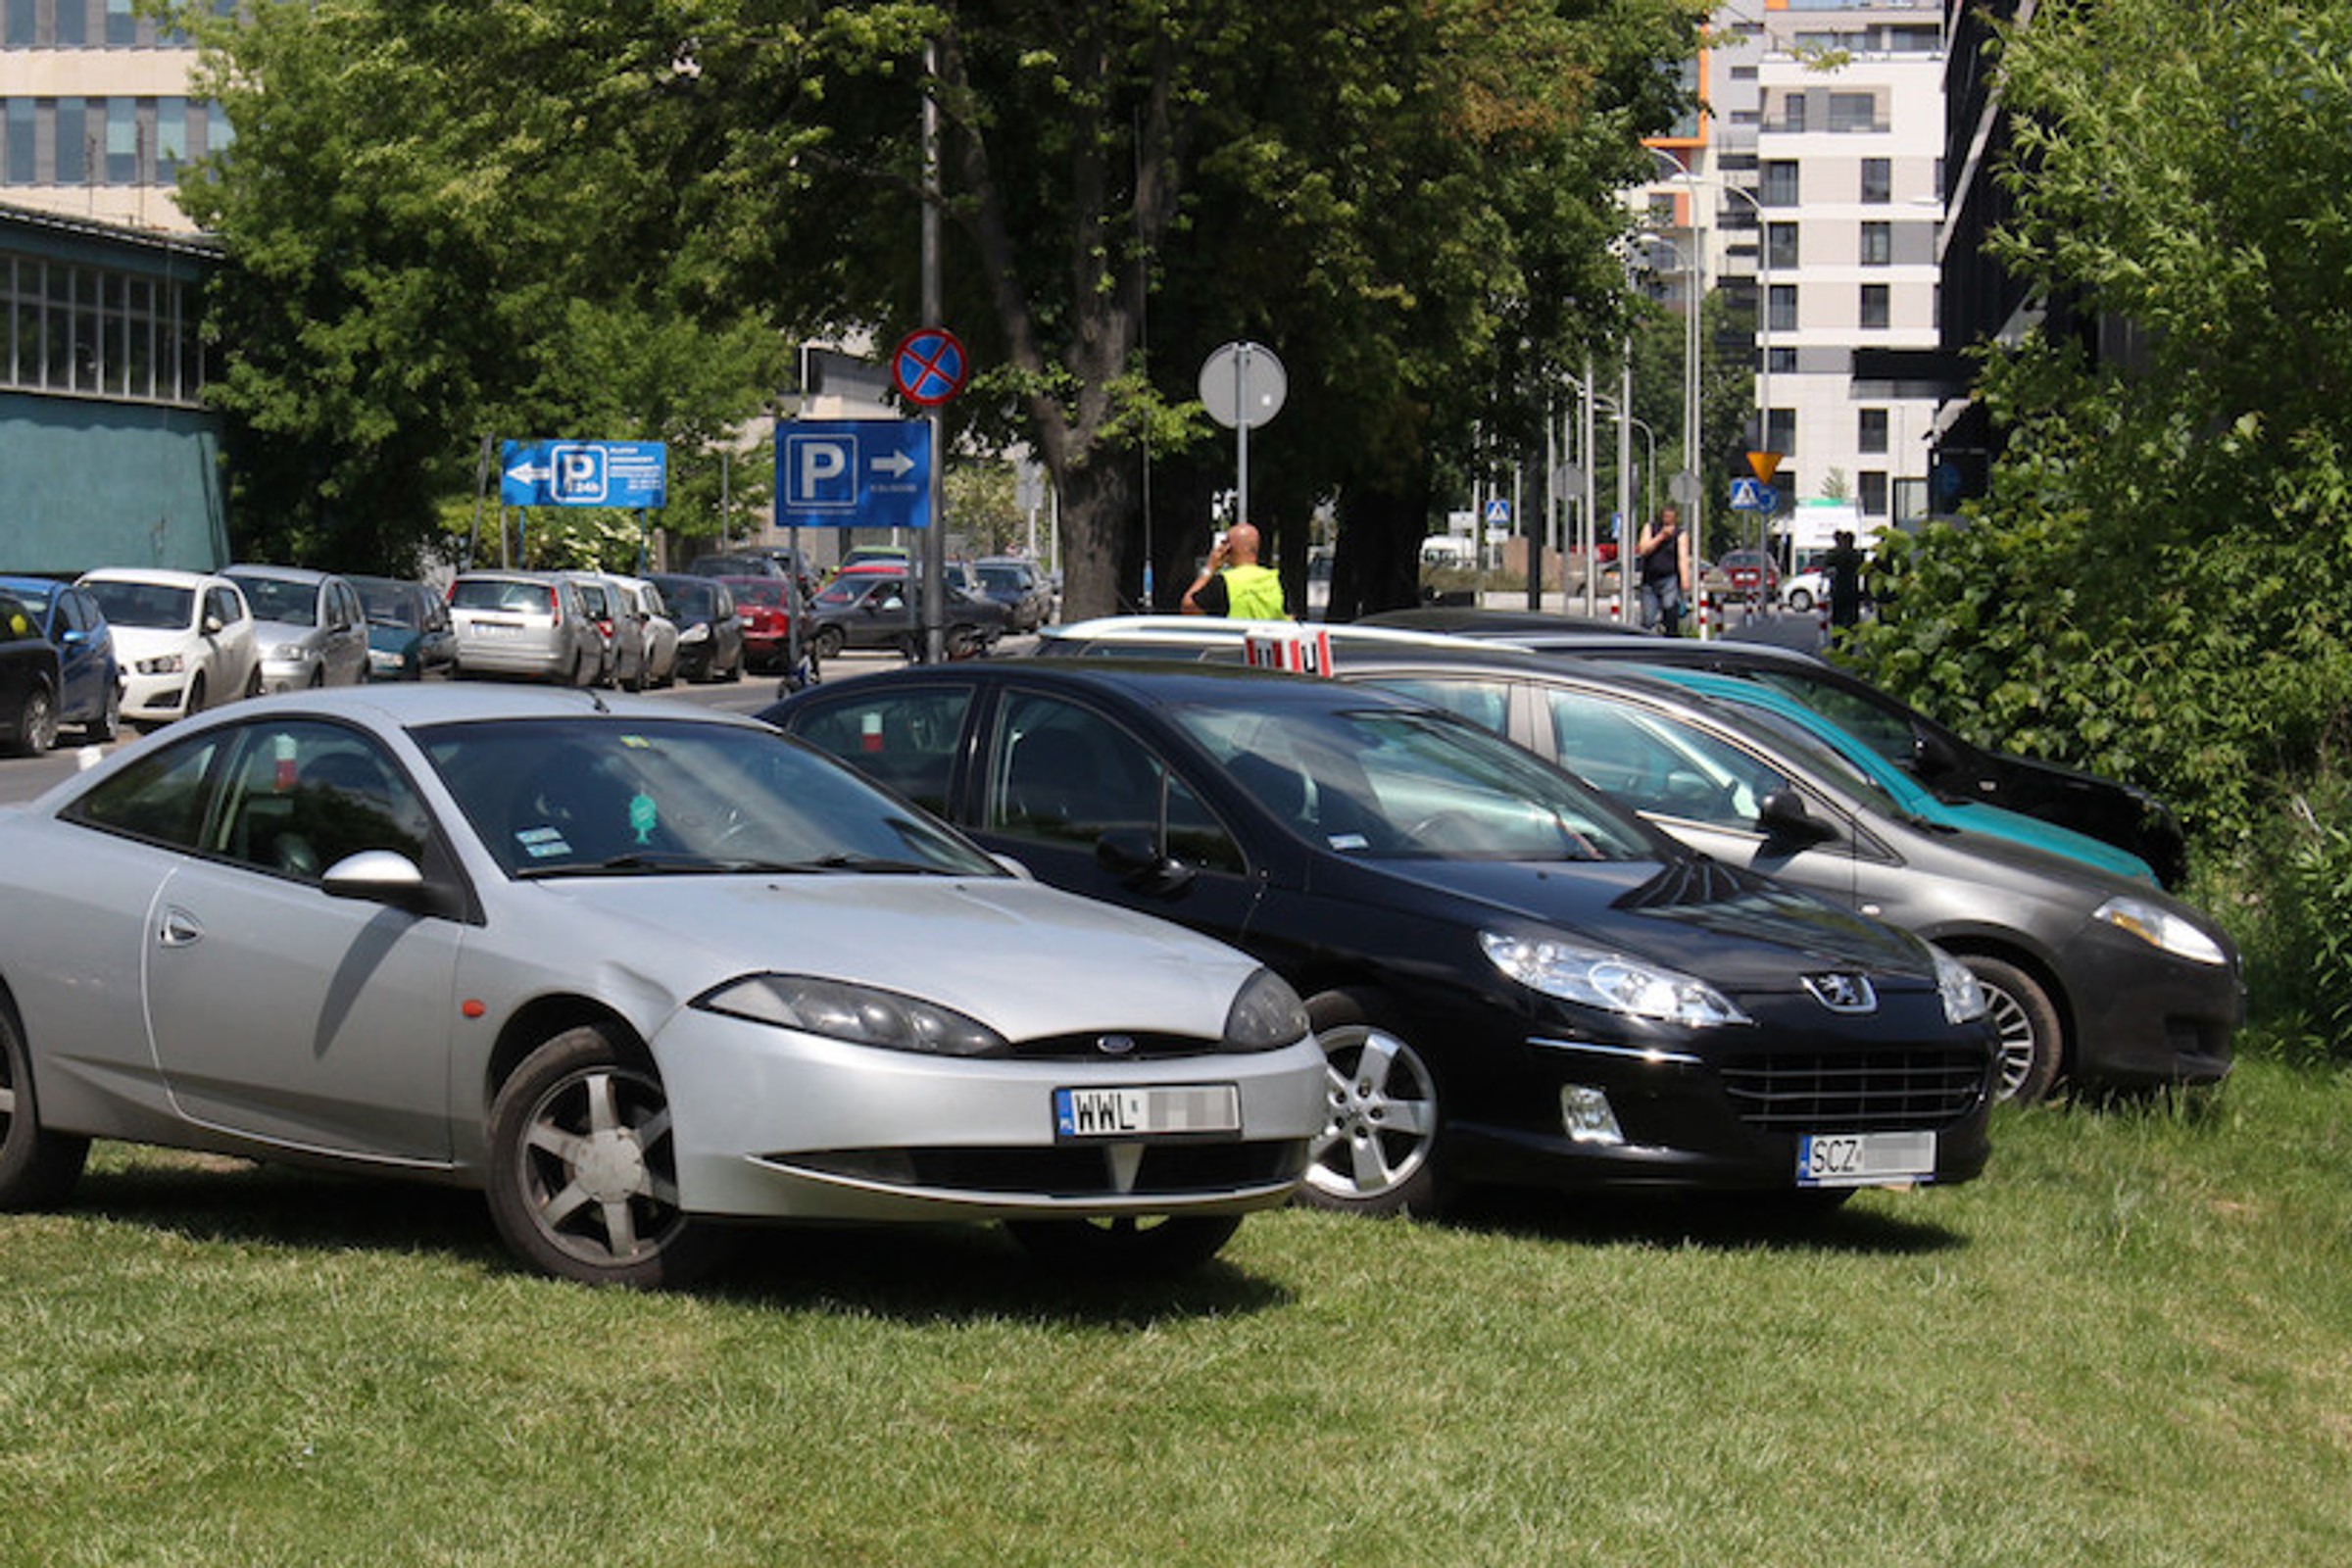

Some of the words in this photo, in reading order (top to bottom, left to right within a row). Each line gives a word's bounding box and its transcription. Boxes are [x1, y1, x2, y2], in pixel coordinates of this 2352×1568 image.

[564, 455, 595, 492] P
[802, 442, 845, 499] P
[1076, 1092, 1135, 1131] WWL
[1812, 1140, 1857, 1173] SCZ
